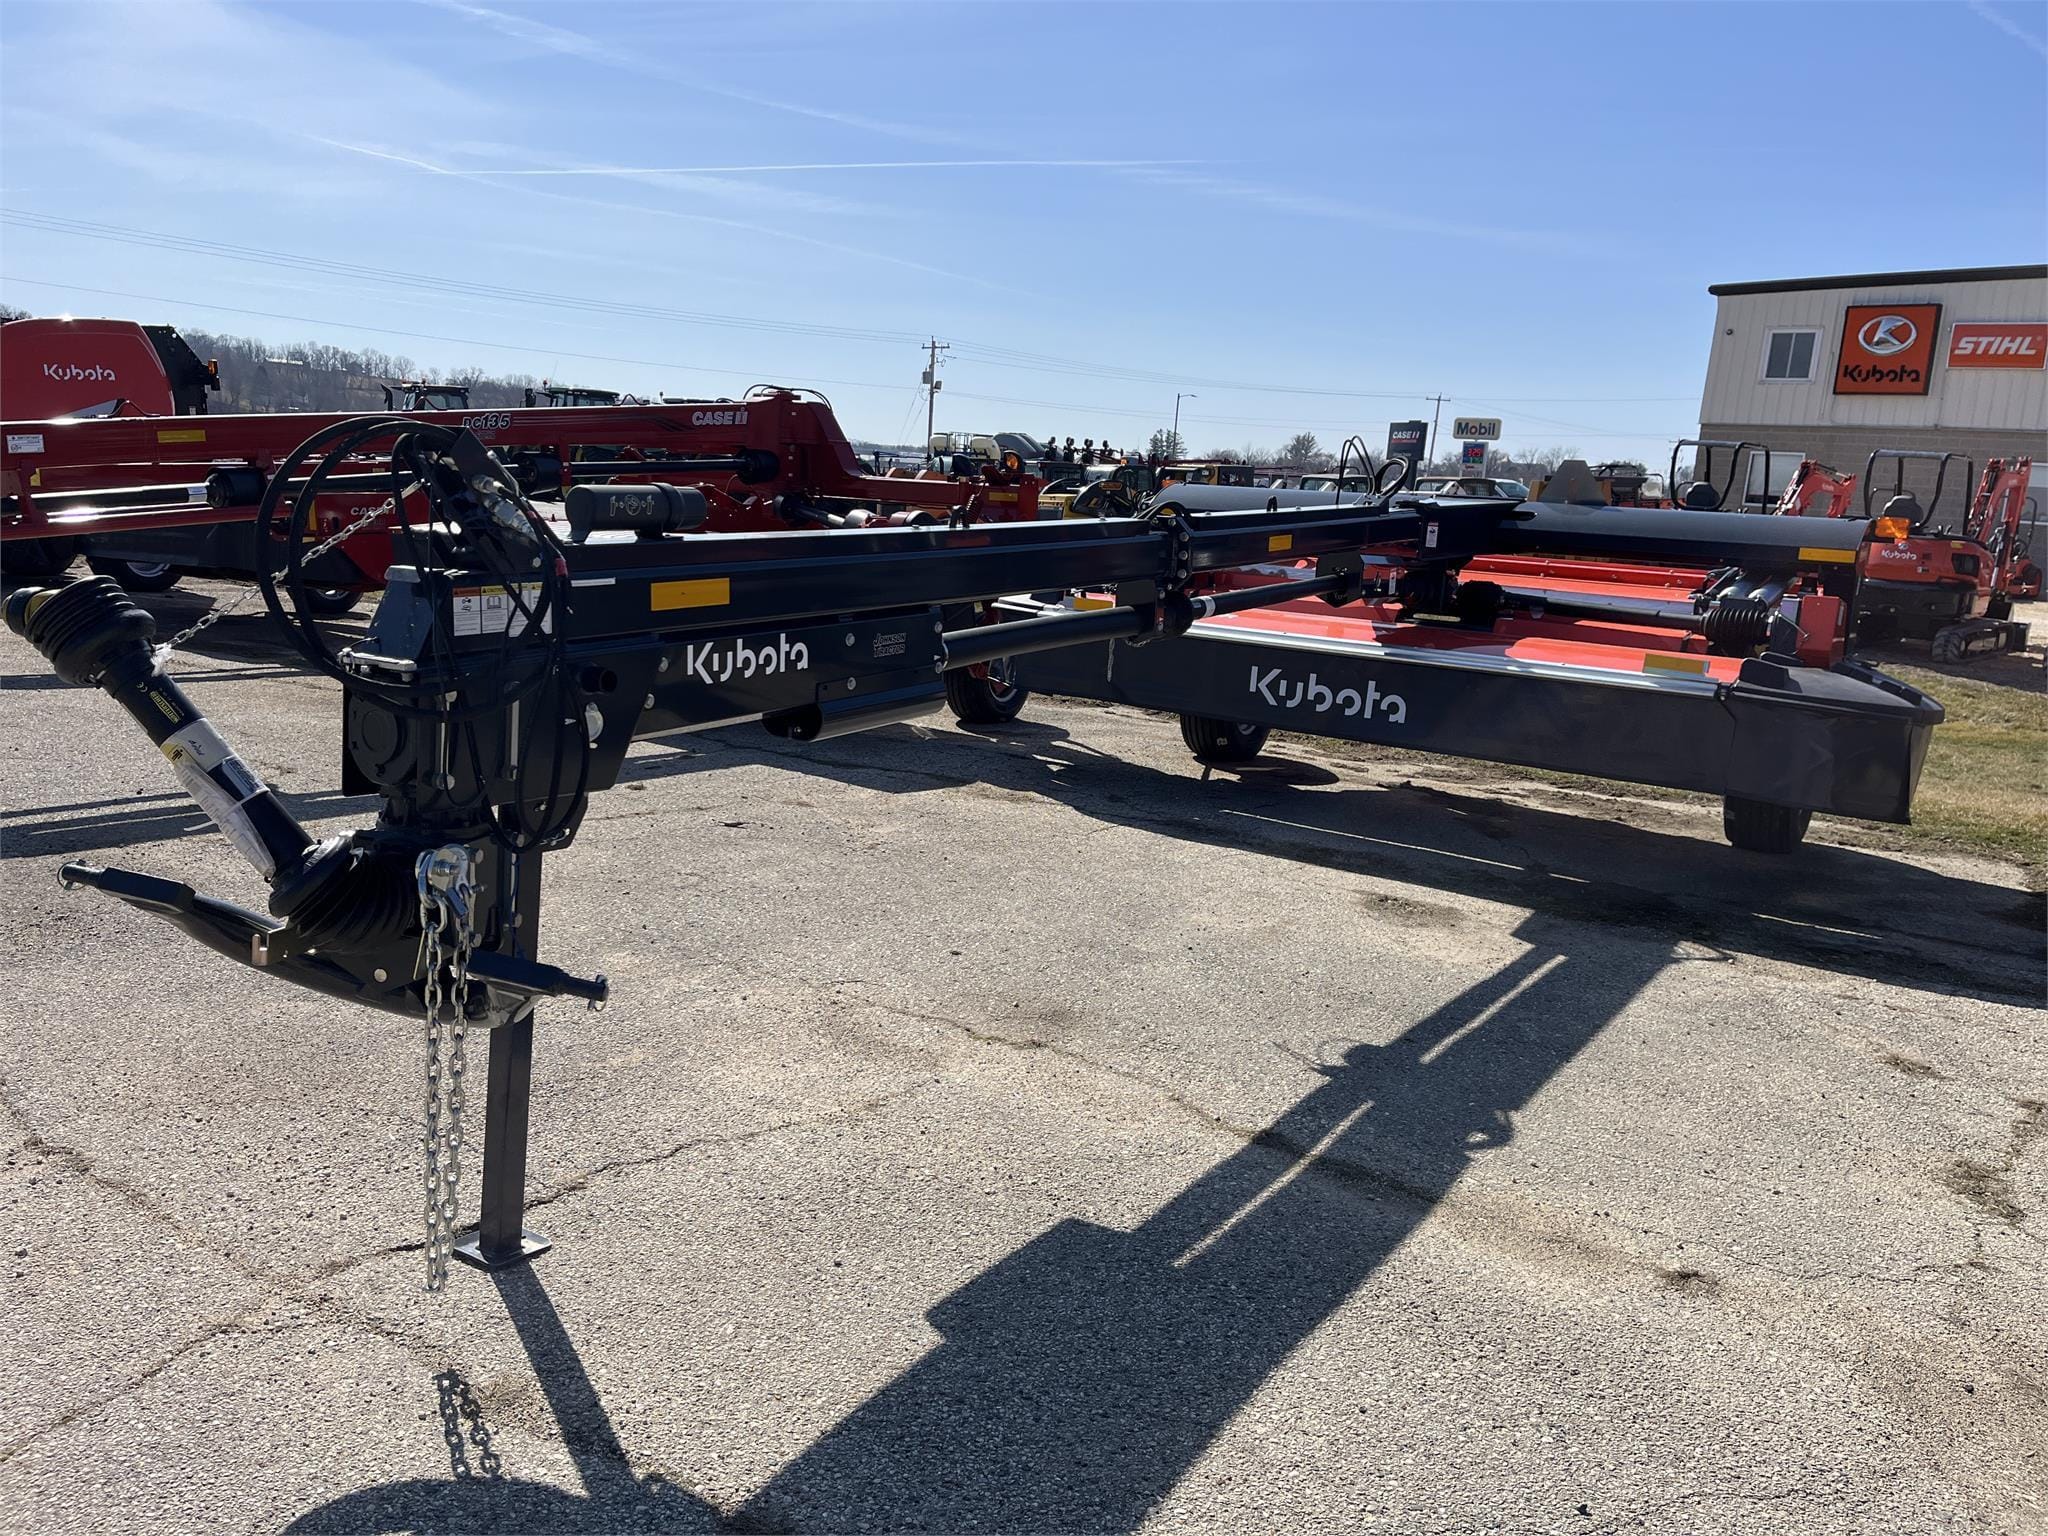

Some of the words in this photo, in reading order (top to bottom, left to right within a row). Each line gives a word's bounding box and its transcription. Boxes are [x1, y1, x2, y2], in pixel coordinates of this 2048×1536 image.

[1954, 336, 2036, 356] STIHL
[43, 363, 116, 381] Kubota
[1843, 364, 1921, 383] Kubota
[691, 411, 733, 426] CASE
[1392, 431, 1411, 439] CASE
[1456, 422, 1496, 436] Mobil
[1881, 549, 1917, 560] Kubota
[687, 633, 808, 684] Kubota
[1250, 665, 1407, 724] Kubota
